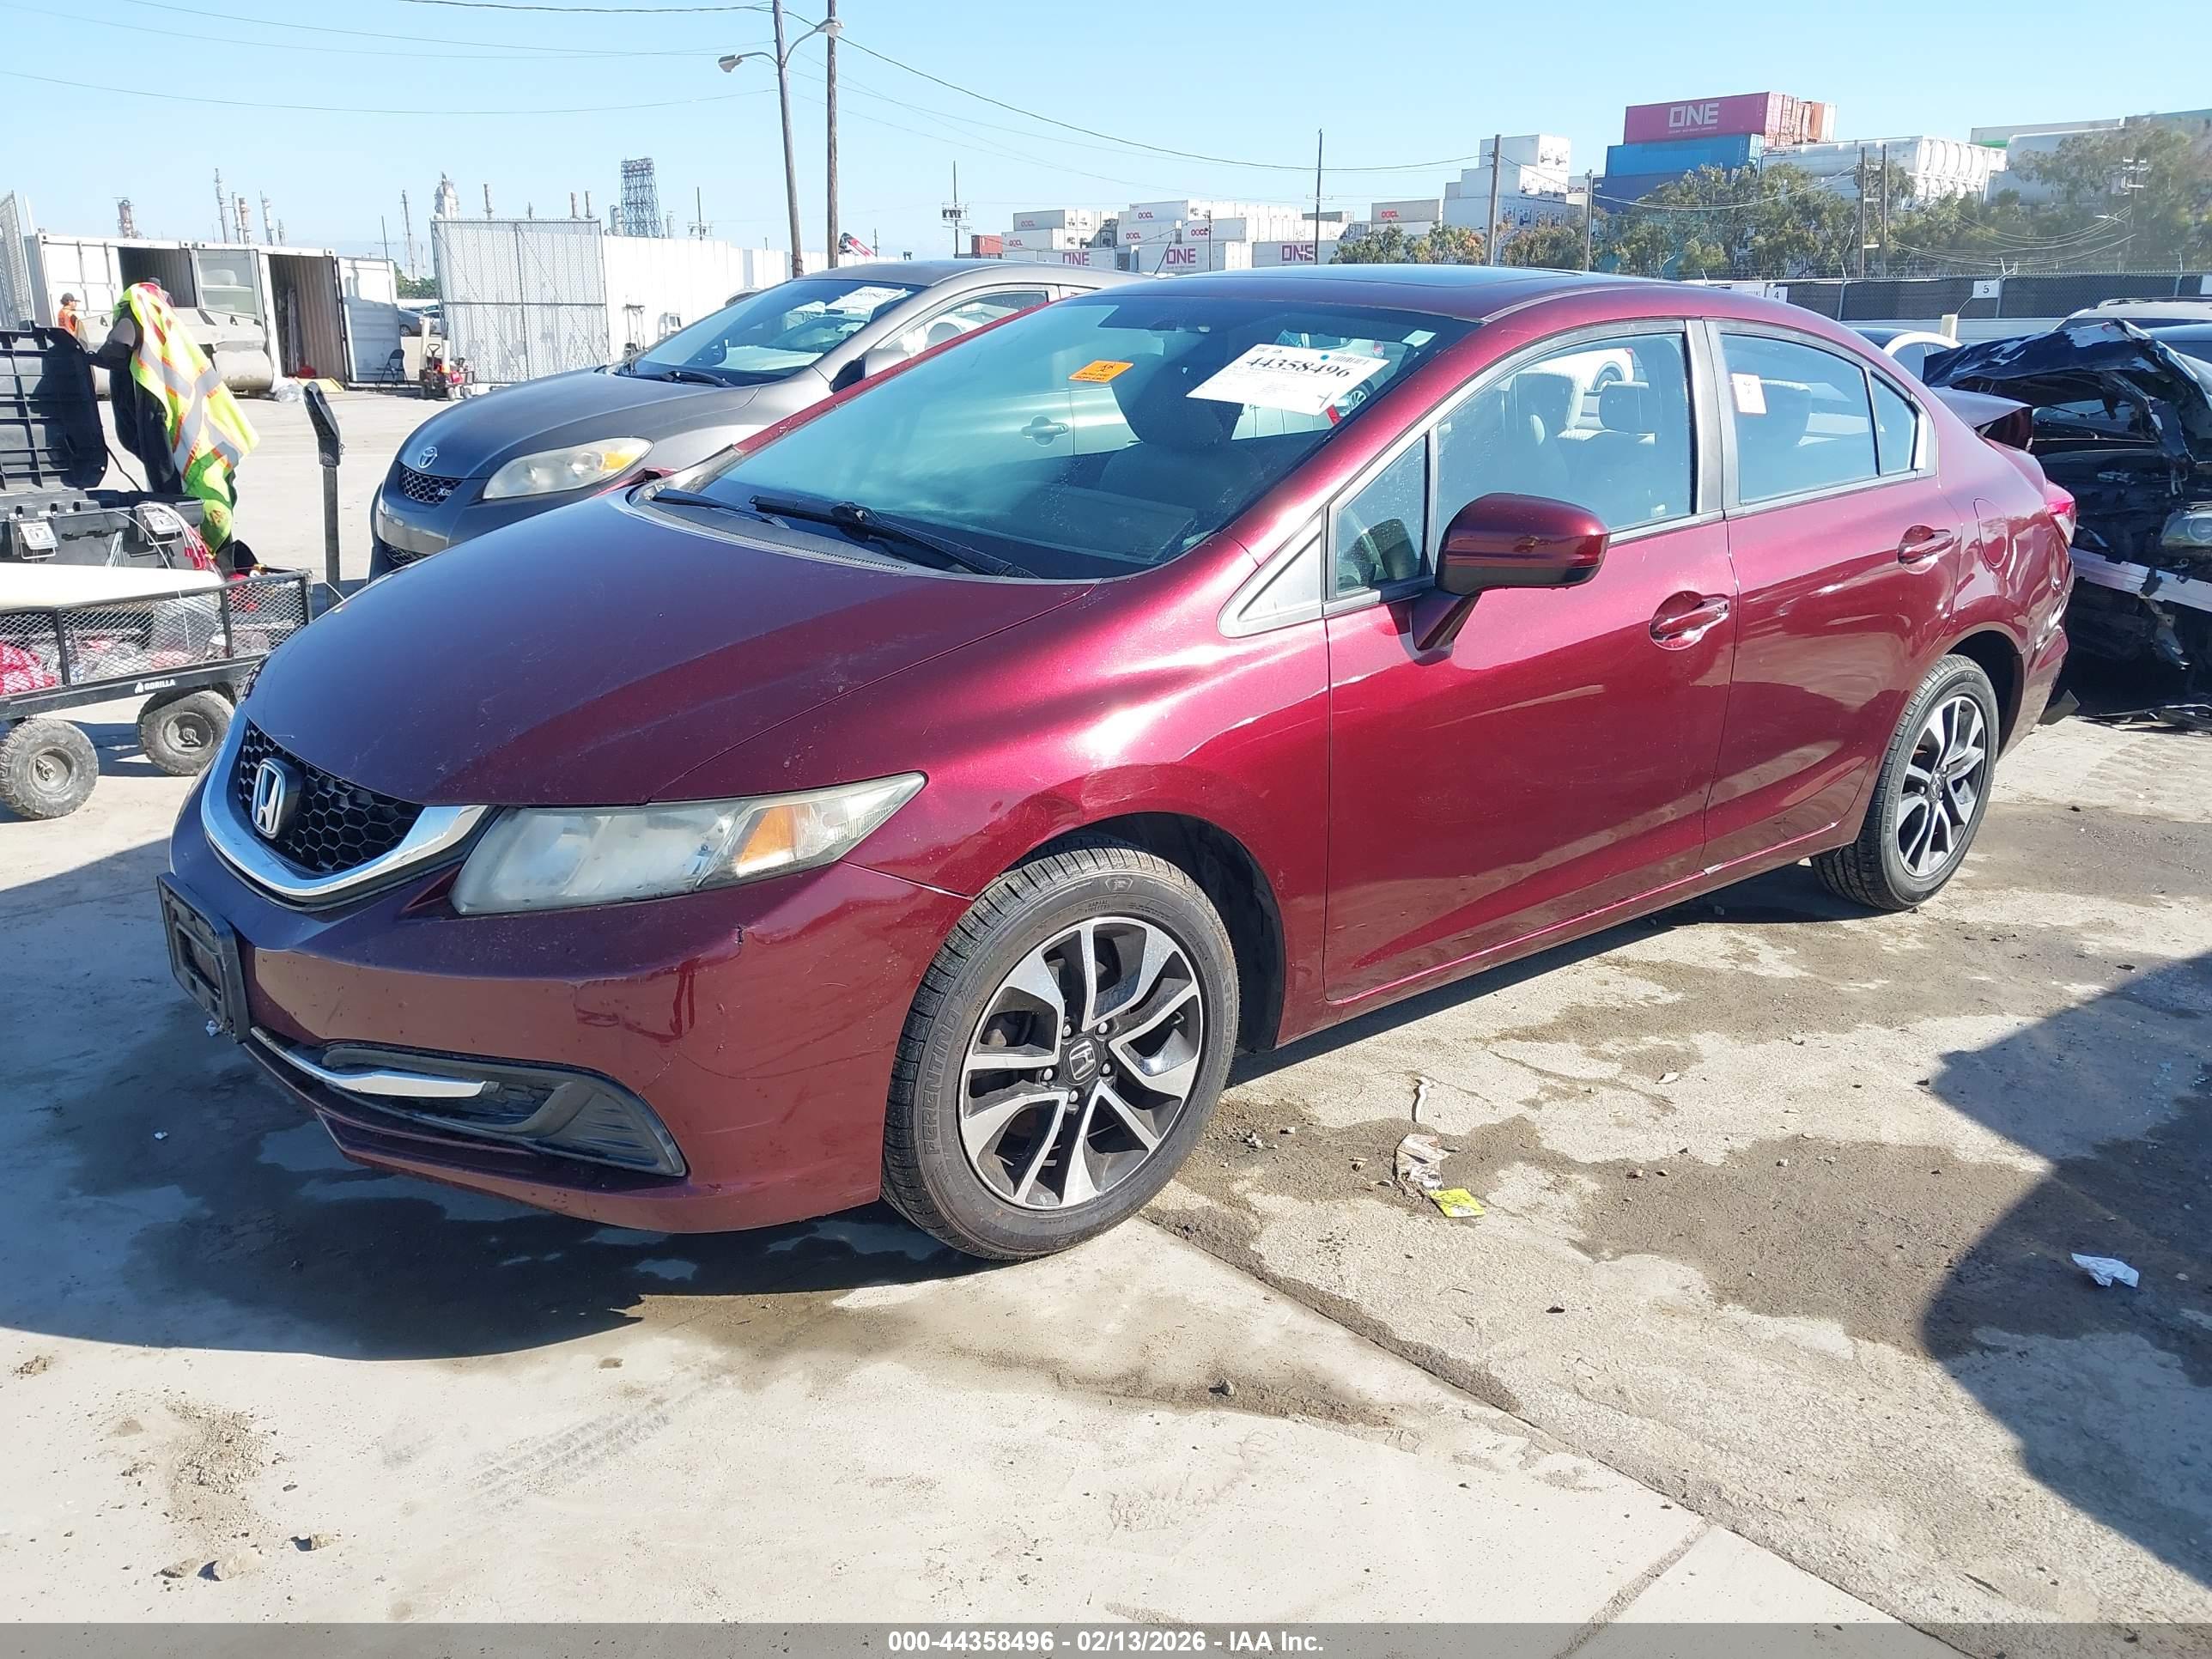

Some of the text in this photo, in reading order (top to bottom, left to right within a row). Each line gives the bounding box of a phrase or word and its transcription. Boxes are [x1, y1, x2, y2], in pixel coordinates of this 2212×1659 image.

[1669, 103, 1718, 127] ONE
[1167, 248, 1195, 264] ONE
[1281, 244, 1314, 261] ONE
[1983, 284, 1990, 294] 5
[1246, 356, 1353, 378] 44358496
[144, 679, 175, 690] GORILLA
[922, 1008, 961, 1155] FERENTINO
